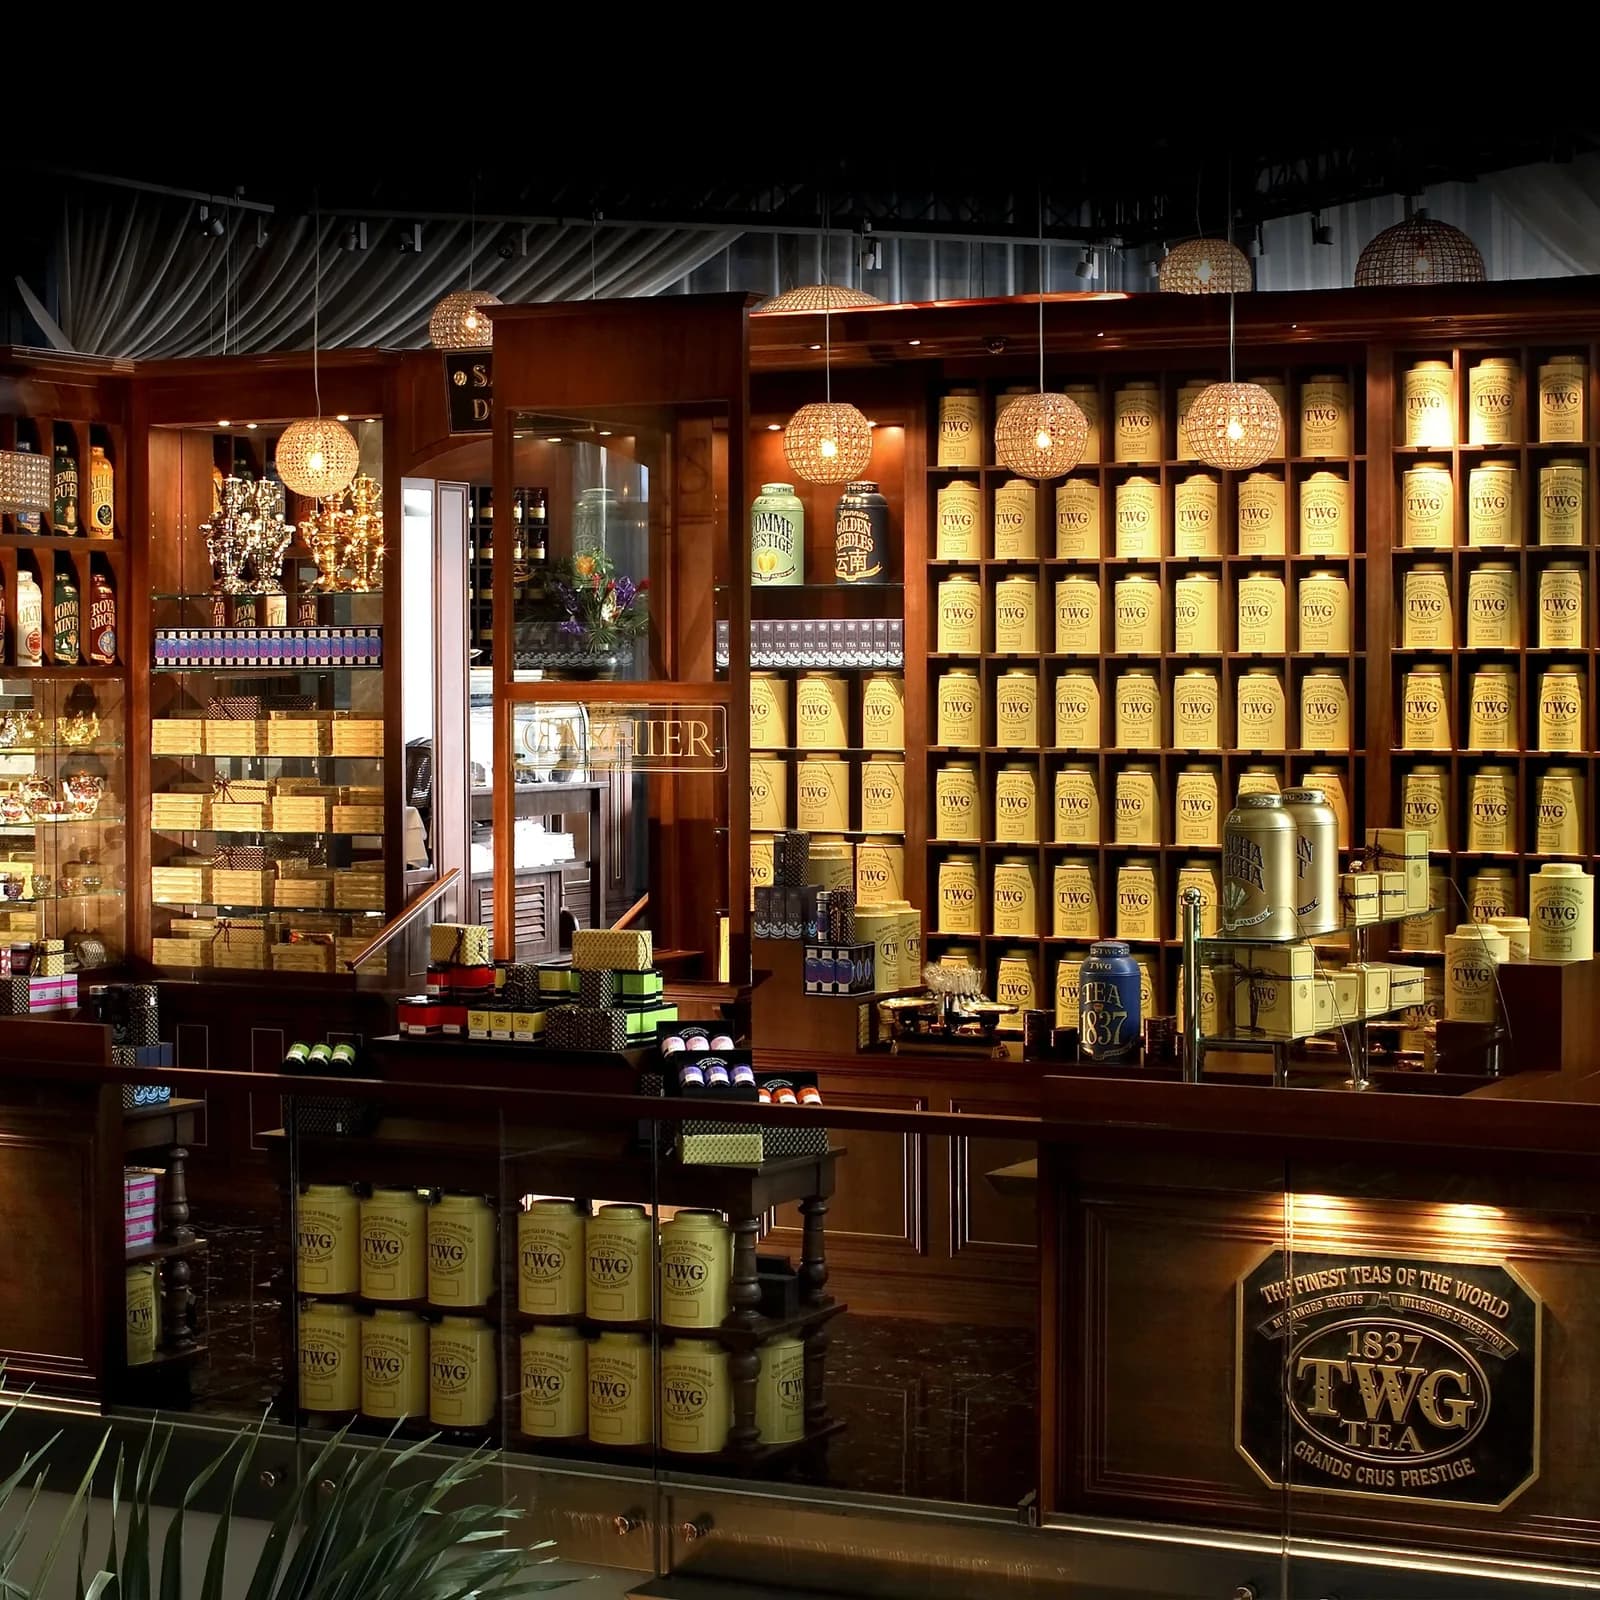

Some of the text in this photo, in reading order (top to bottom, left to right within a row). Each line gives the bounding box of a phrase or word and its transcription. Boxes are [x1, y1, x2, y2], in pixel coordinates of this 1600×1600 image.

[1408, 397, 1440, 409] TWG
[1477, 395, 1511, 406] TWG
[1545, 393, 1578, 404] TWG
[1305, 409, 1337, 420] TWG
[942, 422, 969, 432] TWG
[1120, 416, 1149, 427] TWG
[1408, 499, 1440, 510] TWG
[1474, 497, 1505, 508] TWG
[1544, 496, 1577, 507] TWG
[1060, 513, 1088, 523] TWG
[1119, 511, 1146, 522] TWG
[1179, 510, 1209, 521] TWG
[1241, 509, 1270, 519] TWG
[1305, 507, 1337, 518] TWG
[943, 514, 972, 524] TWG
[997, 514, 1022, 524] TWG
[837, 518, 872, 537] GOLDEN
[753, 533, 793, 557] RESTIGE
[836, 534, 873, 552] NEEDLES
[837, 549, 866, 571] 云南
[1410, 600, 1441, 611] TWG
[1473, 599, 1505, 610] TWG
[1544, 599, 1577, 610] TWG
[944, 608, 974, 618] TWG
[999, 607, 1024, 618] TWG
[1060, 607, 1089, 618] TWG
[1119, 607, 1146, 618] TWG
[1241, 606, 1268, 617] TWG
[1303, 605, 1332, 616] TWG
[801, 705, 828, 715] TWG
[866, 705, 891, 715] TWG
[944, 702, 972, 712] TWG
[1001, 703, 1029, 713] TWG
[1059, 702, 1086, 713] TWG
[1122, 702, 1152, 713] TWG
[1181, 703, 1211, 714] TWG
[1242, 703, 1272, 714] TWG
[1306, 703, 1338, 714] TWG
[1407, 702, 1437, 713] TWG
[1475, 702, 1508, 713] TWG
[1544, 702, 1577, 713] TWG
[801, 787, 827, 797] TWG
[865, 788, 892, 798] TWG
[941, 796, 970, 806] TWG
[1000, 797, 1028, 808] TWG
[1059, 798, 1089, 808] TWG
[1116, 799, 1141, 809] TWG
[1182, 800, 1212, 811] TWG
[1406, 803, 1437, 815] TWG
[1474, 803, 1508, 815] TWG
[860, 870, 886, 881] TWG
[944, 889, 974, 900] TWG
[996, 891, 1023, 901] TWG
[1060, 893, 1090, 903] TWG
[1119, 893, 1148, 905] TWG
[1473, 905, 1506, 917] TWG
[1539, 907, 1576, 919] TWG
[1090, 962, 1111, 970] TWG
[1453, 969, 1491, 981] TWG
[1000, 984, 1029, 996] TWG
[1061, 985, 1079, 997] TW
[1082, 983, 1123, 1008] TEA
[1081, 1011, 1127, 1045] 1837
[298, 1234, 331, 1248] TWG
[364, 1239, 399, 1253] TWG
[431, 1244, 463, 1259] TWG
[522, 1252, 560, 1267] TWG
[590, 1258, 628, 1273] TWG
[666, 1263, 703, 1279] TWG
[1260, 1266, 1510, 1319] THE FINEST TEAS OF THE WORLD
[1326, 1295, 1363, 1308] EXQUIS
[1452, 1312, 1506, 1351] D'EXCEPTION
[1346, 1330, 1424, 1363] 1837
[301, 1351, 336, 1365] TWG
[365, 1357, 399, 1372] TWG
[432, 1364, 467, 1379] TWG
[524, 1374, 560, 1389] TWG
[531, 1389, 548, 1398] TEA
[591, 1381, 626, 1397] TWG
[1296, 1357, 1478, 1430] TWG
[665, 1388, 702, 1404] TWG
[672, 1404, 690, 1412] TEA
[1340, 1419, 1425, 1454] TEA
[1294, 1440, 1476, 1487] GRANDS CRUS PRESTIGE
